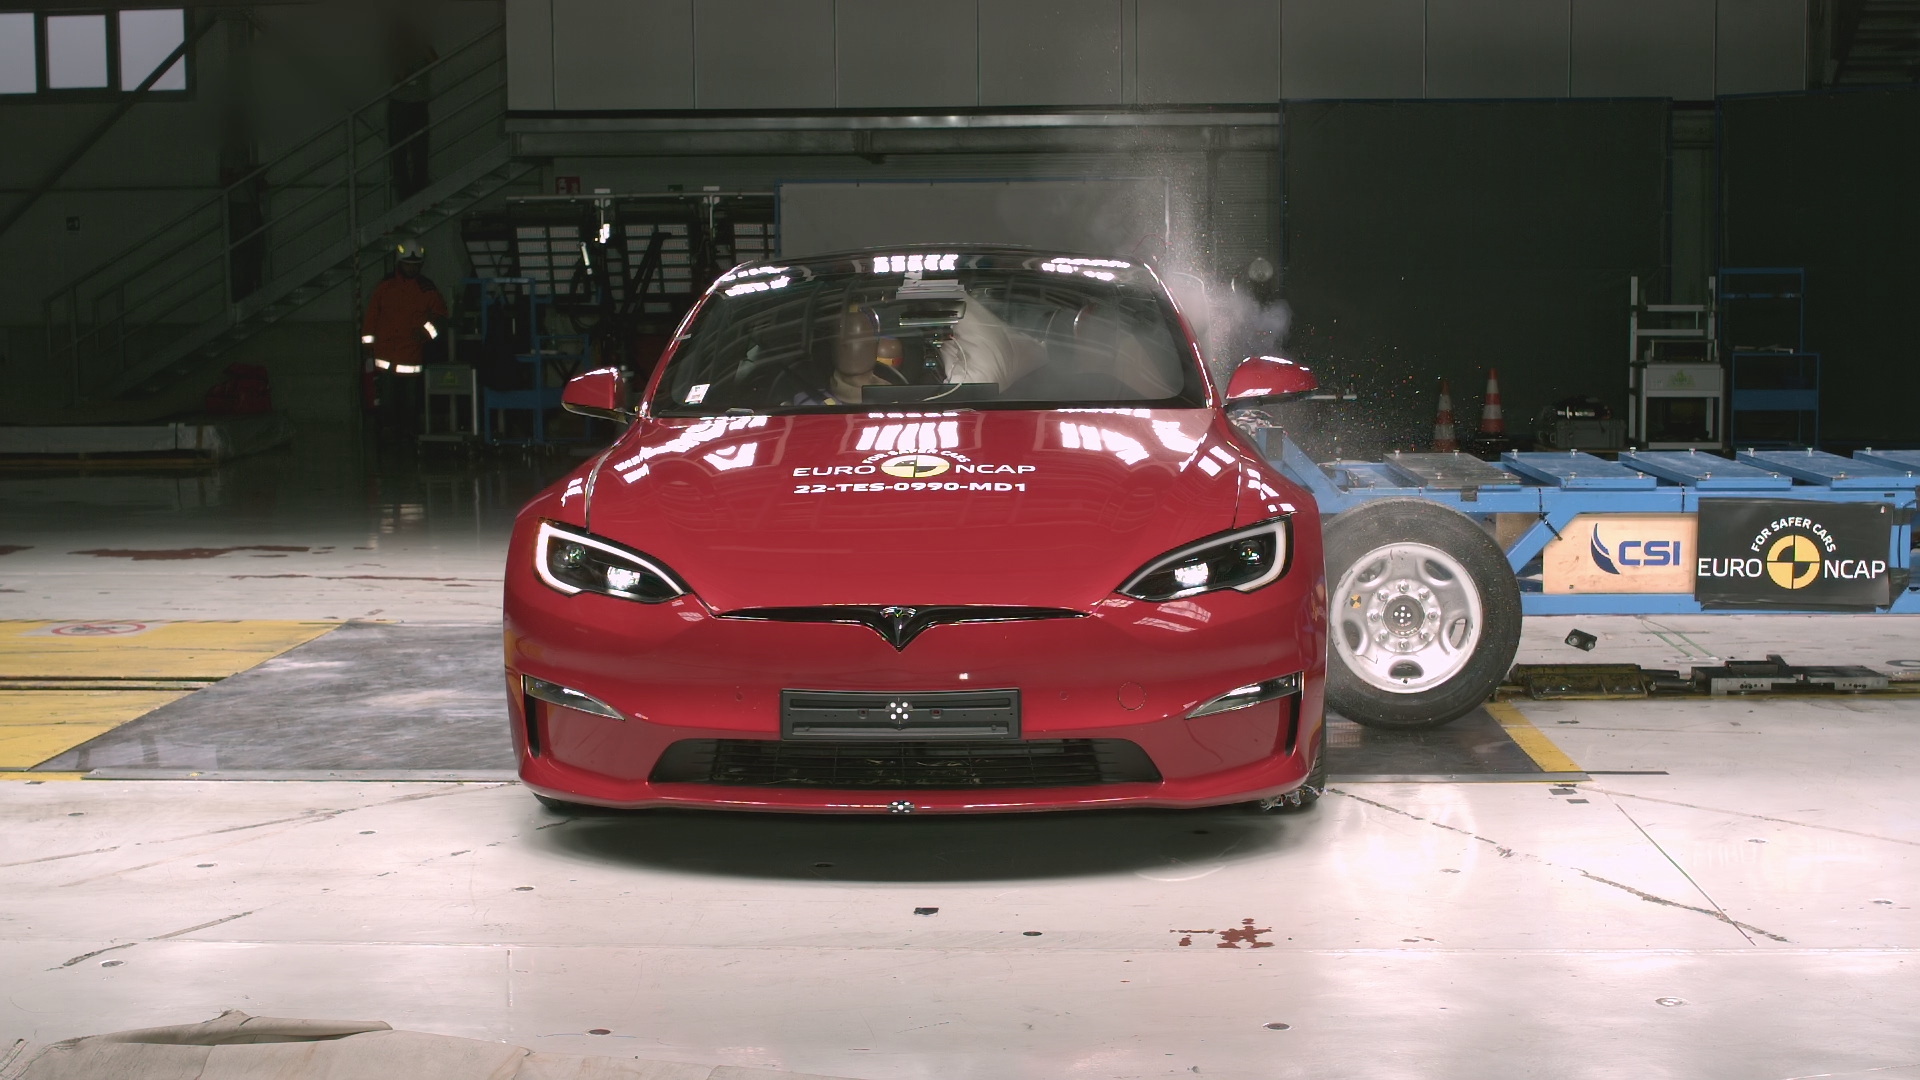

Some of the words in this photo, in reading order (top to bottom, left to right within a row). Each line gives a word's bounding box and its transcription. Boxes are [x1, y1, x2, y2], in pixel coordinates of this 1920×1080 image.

[862, 453, 889, 464] FOR
[941, 450, 971, 463] CARS
[792, 466, 876, 477] EURO
[955, 464, 1036, 474] NCAP
[793, 483, 1026, 494] 22-TES-0990-MD1
[1750, 528, 1772, 552] FOR
[1770, 517, 1811, 532] SAFER
[1812, 523, 1836, 553] CARS
[1618, 541, 1681, 566] CSI
[1698, 557, 1762, 578] EURO
[1824, 559, 1886, 579] NCAP
